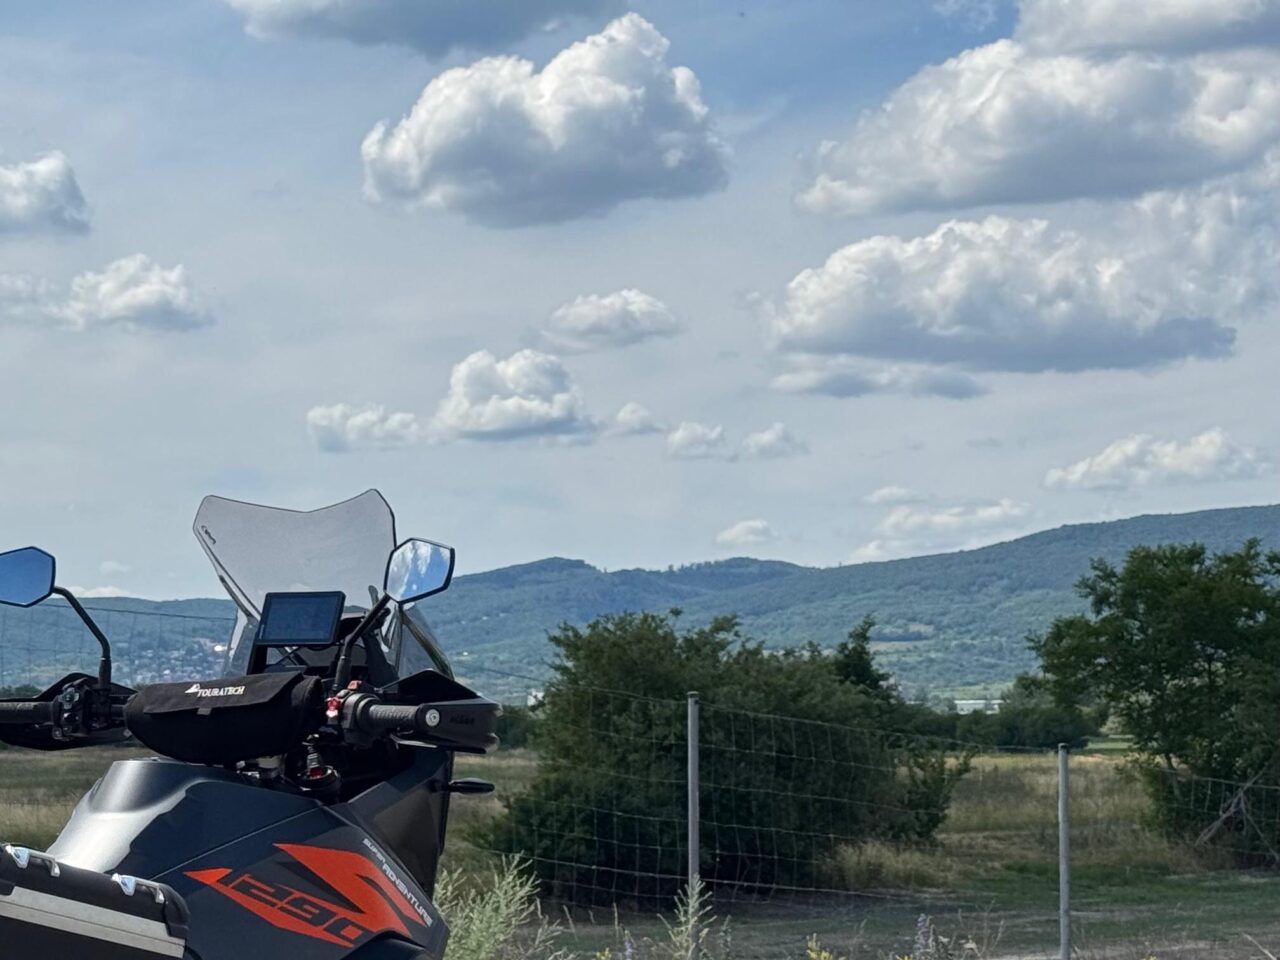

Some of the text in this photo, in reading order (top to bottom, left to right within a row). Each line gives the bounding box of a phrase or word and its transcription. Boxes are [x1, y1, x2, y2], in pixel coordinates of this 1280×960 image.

[196, 685, 245, 697] TOURATECH
[216, 868, 373, 943] 1290
[362, 838, 433, 927] SUPER ADVENTURE
